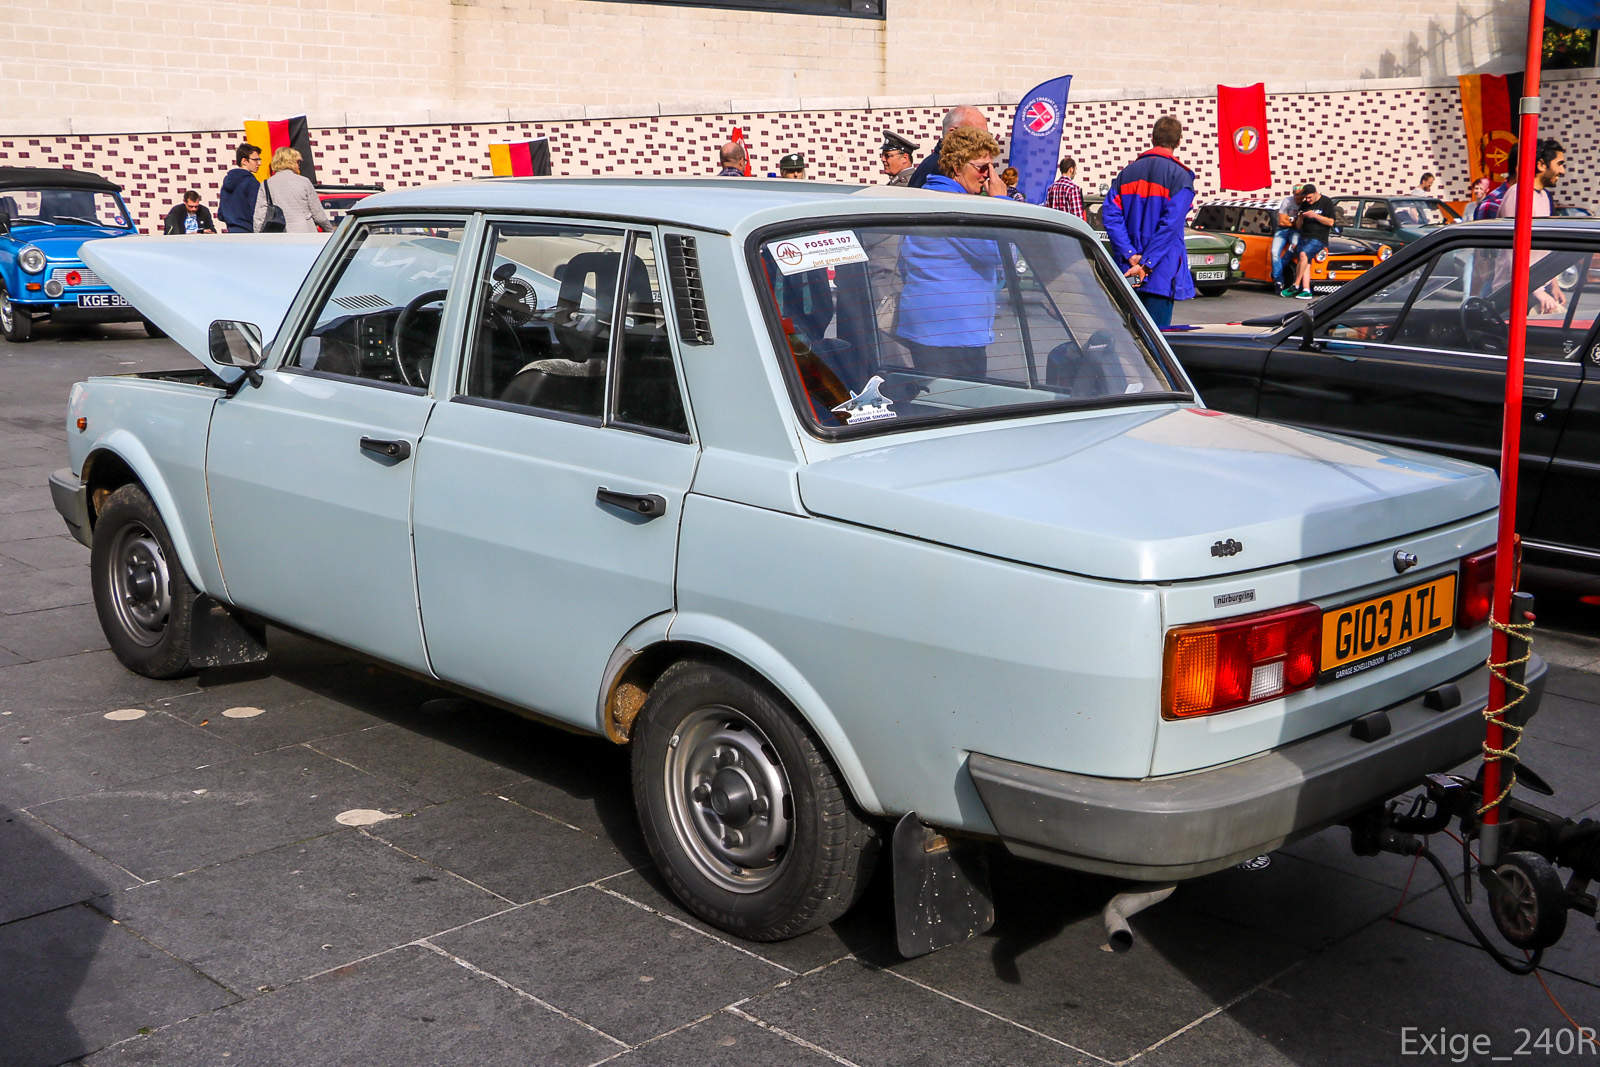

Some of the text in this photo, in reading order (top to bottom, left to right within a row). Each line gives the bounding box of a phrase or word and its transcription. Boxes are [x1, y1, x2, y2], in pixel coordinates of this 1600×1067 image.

[804, 236, 851, 249] FOSSE 107
[825, 257, 841, 265] great
[1213, 271, 1223, 279] YEV
[83, 295, 131, 306] KGE 98
[1217, 591, 1254, 604] nürburgring
[1336, 586, 1441, 660] G103 ATL
[1336, 667, 1353, 679] GARAGE
